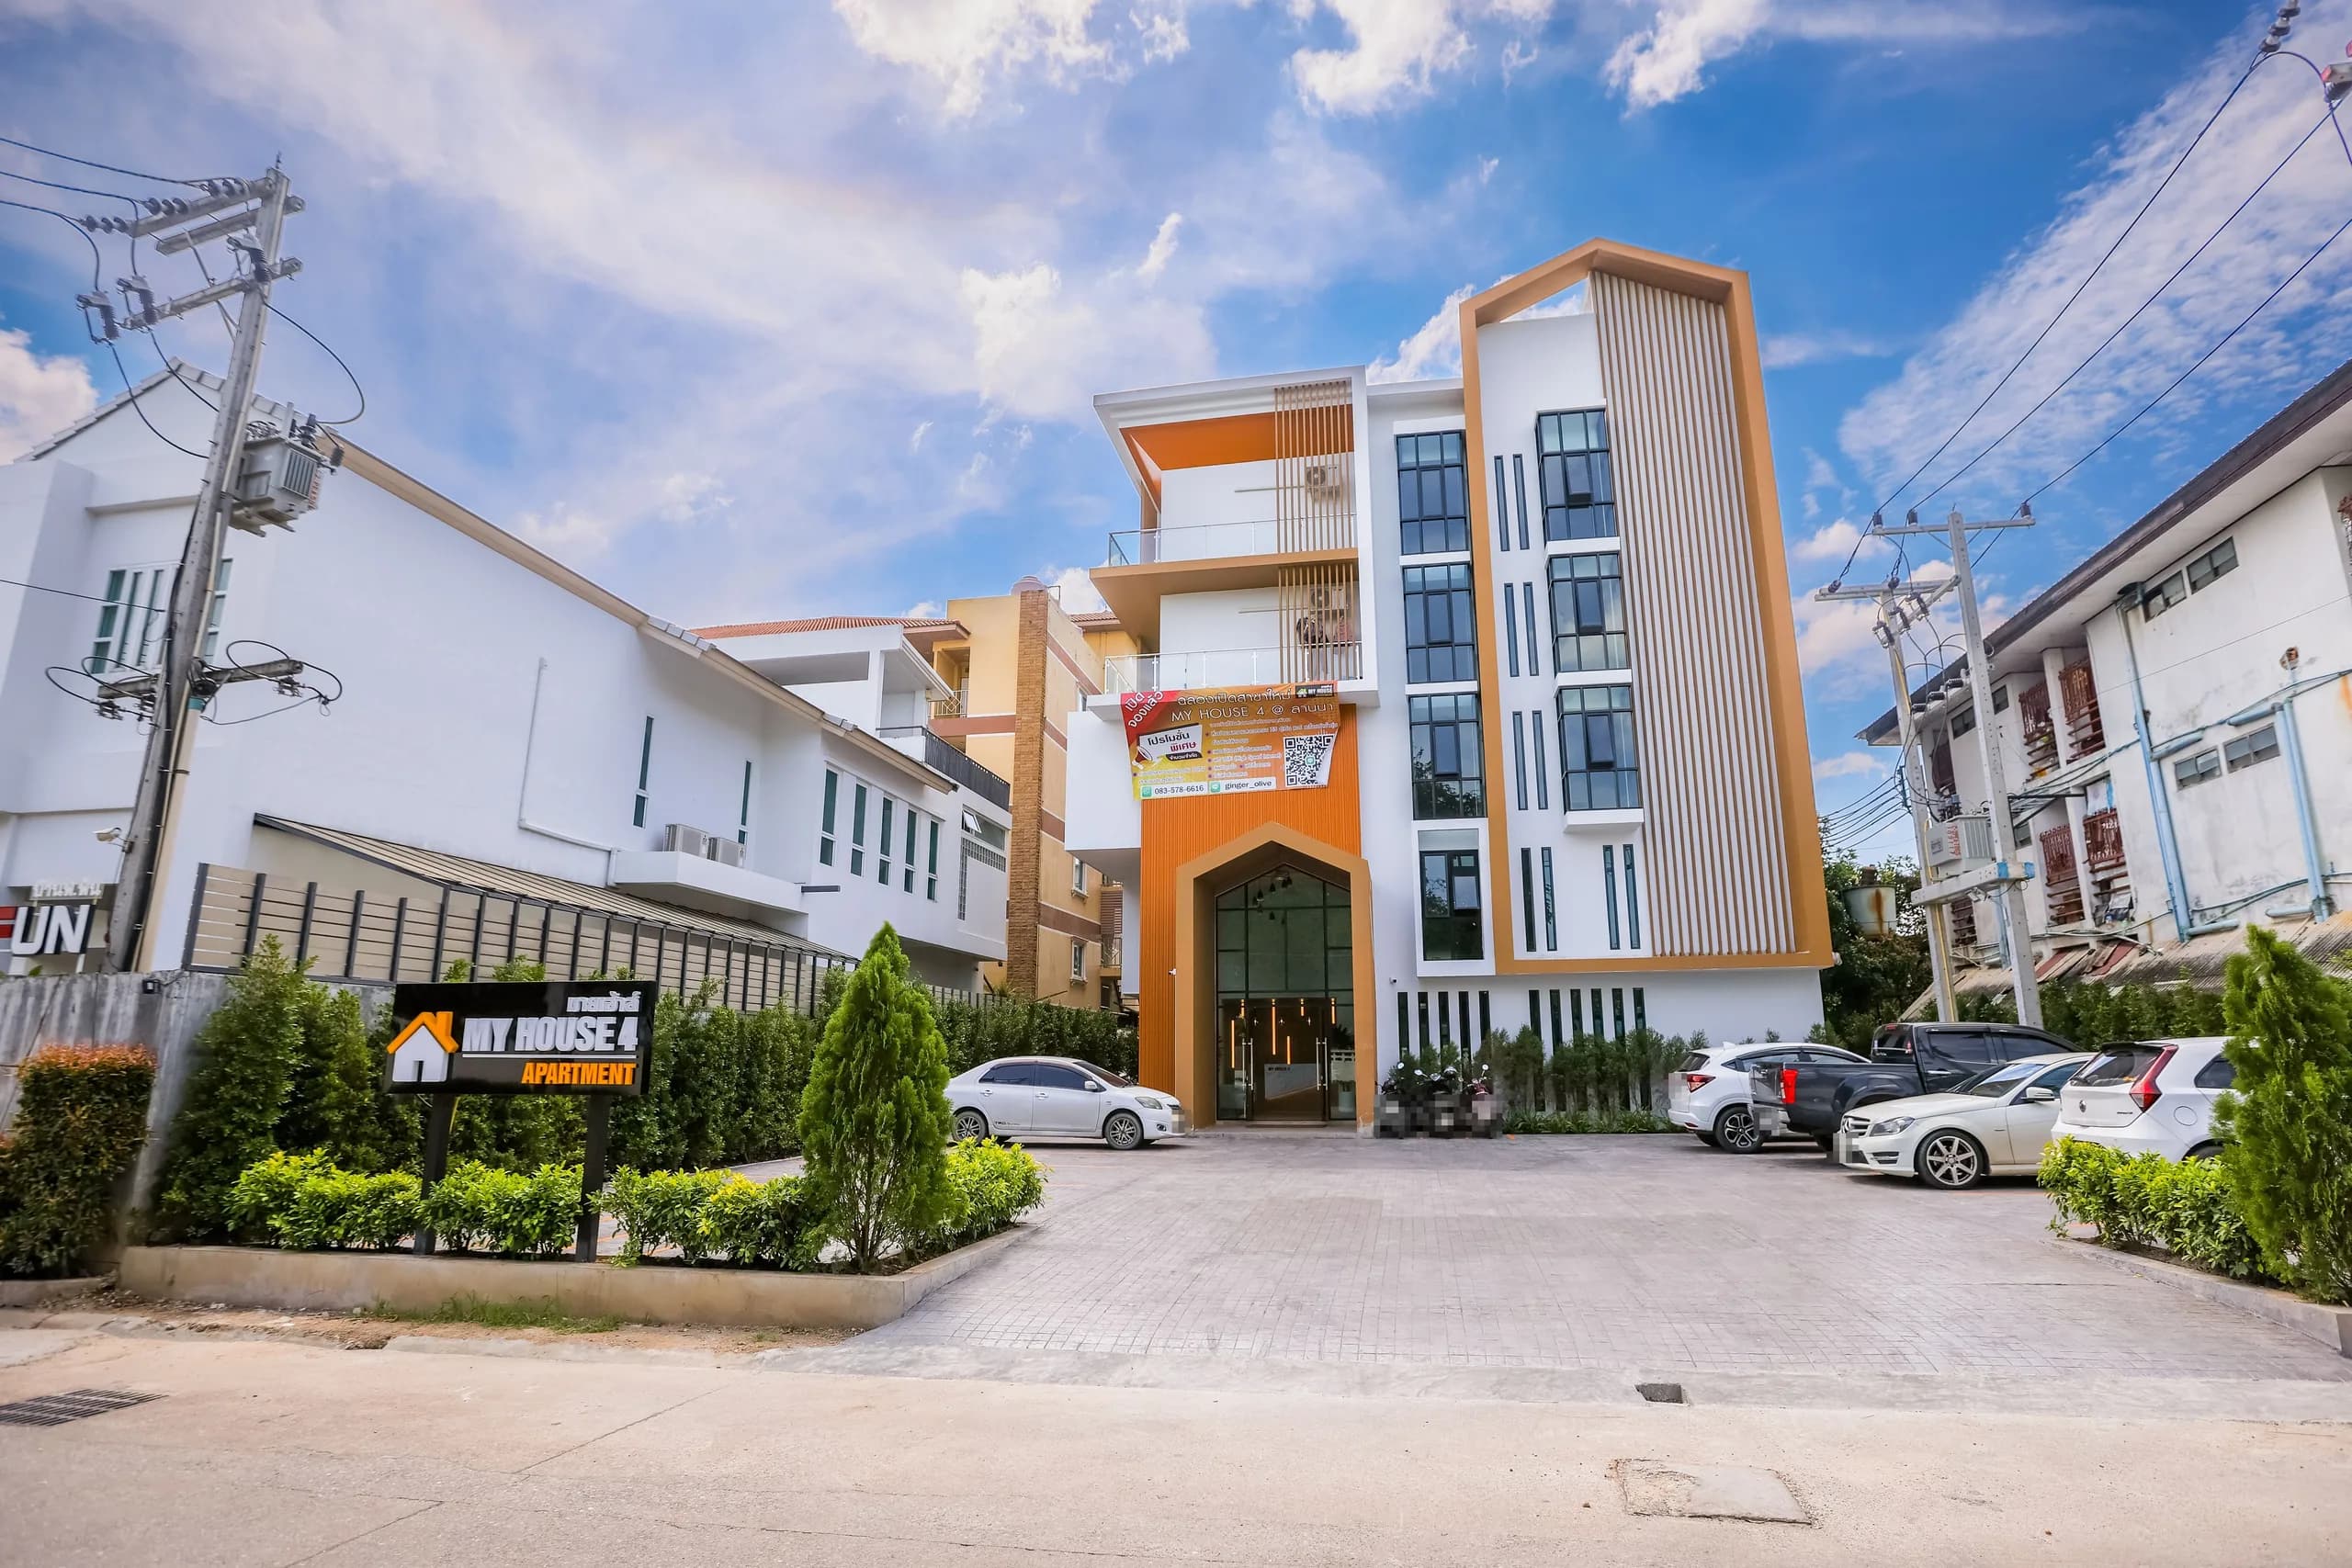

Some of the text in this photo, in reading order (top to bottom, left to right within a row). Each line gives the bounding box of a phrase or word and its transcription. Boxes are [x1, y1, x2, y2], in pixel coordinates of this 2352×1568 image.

[1125, 692, 1145, 711] เปิด
[1177, 688, 1291, 705] ฉลองเปิดสาขาใหม่
[1128, 691, 1163, 728] จองแล้ว
[1171, 703, 1334, 722] MY HOUSE 4 @ ลานนา
[1148, 729, 1190, 746] โปรโมชั่น
[1170, 741, 1197, 752] พิเศษ
[1154, 784, 1204, 795] 083-578-6616
[1225, 780, 1272, 792] ginger_olive
[0, 905, 90, 955] UN
[462, 1016, 639, 1053] MY HOUSE 4
[521, 1062, 637, 1086] APARTMENT
